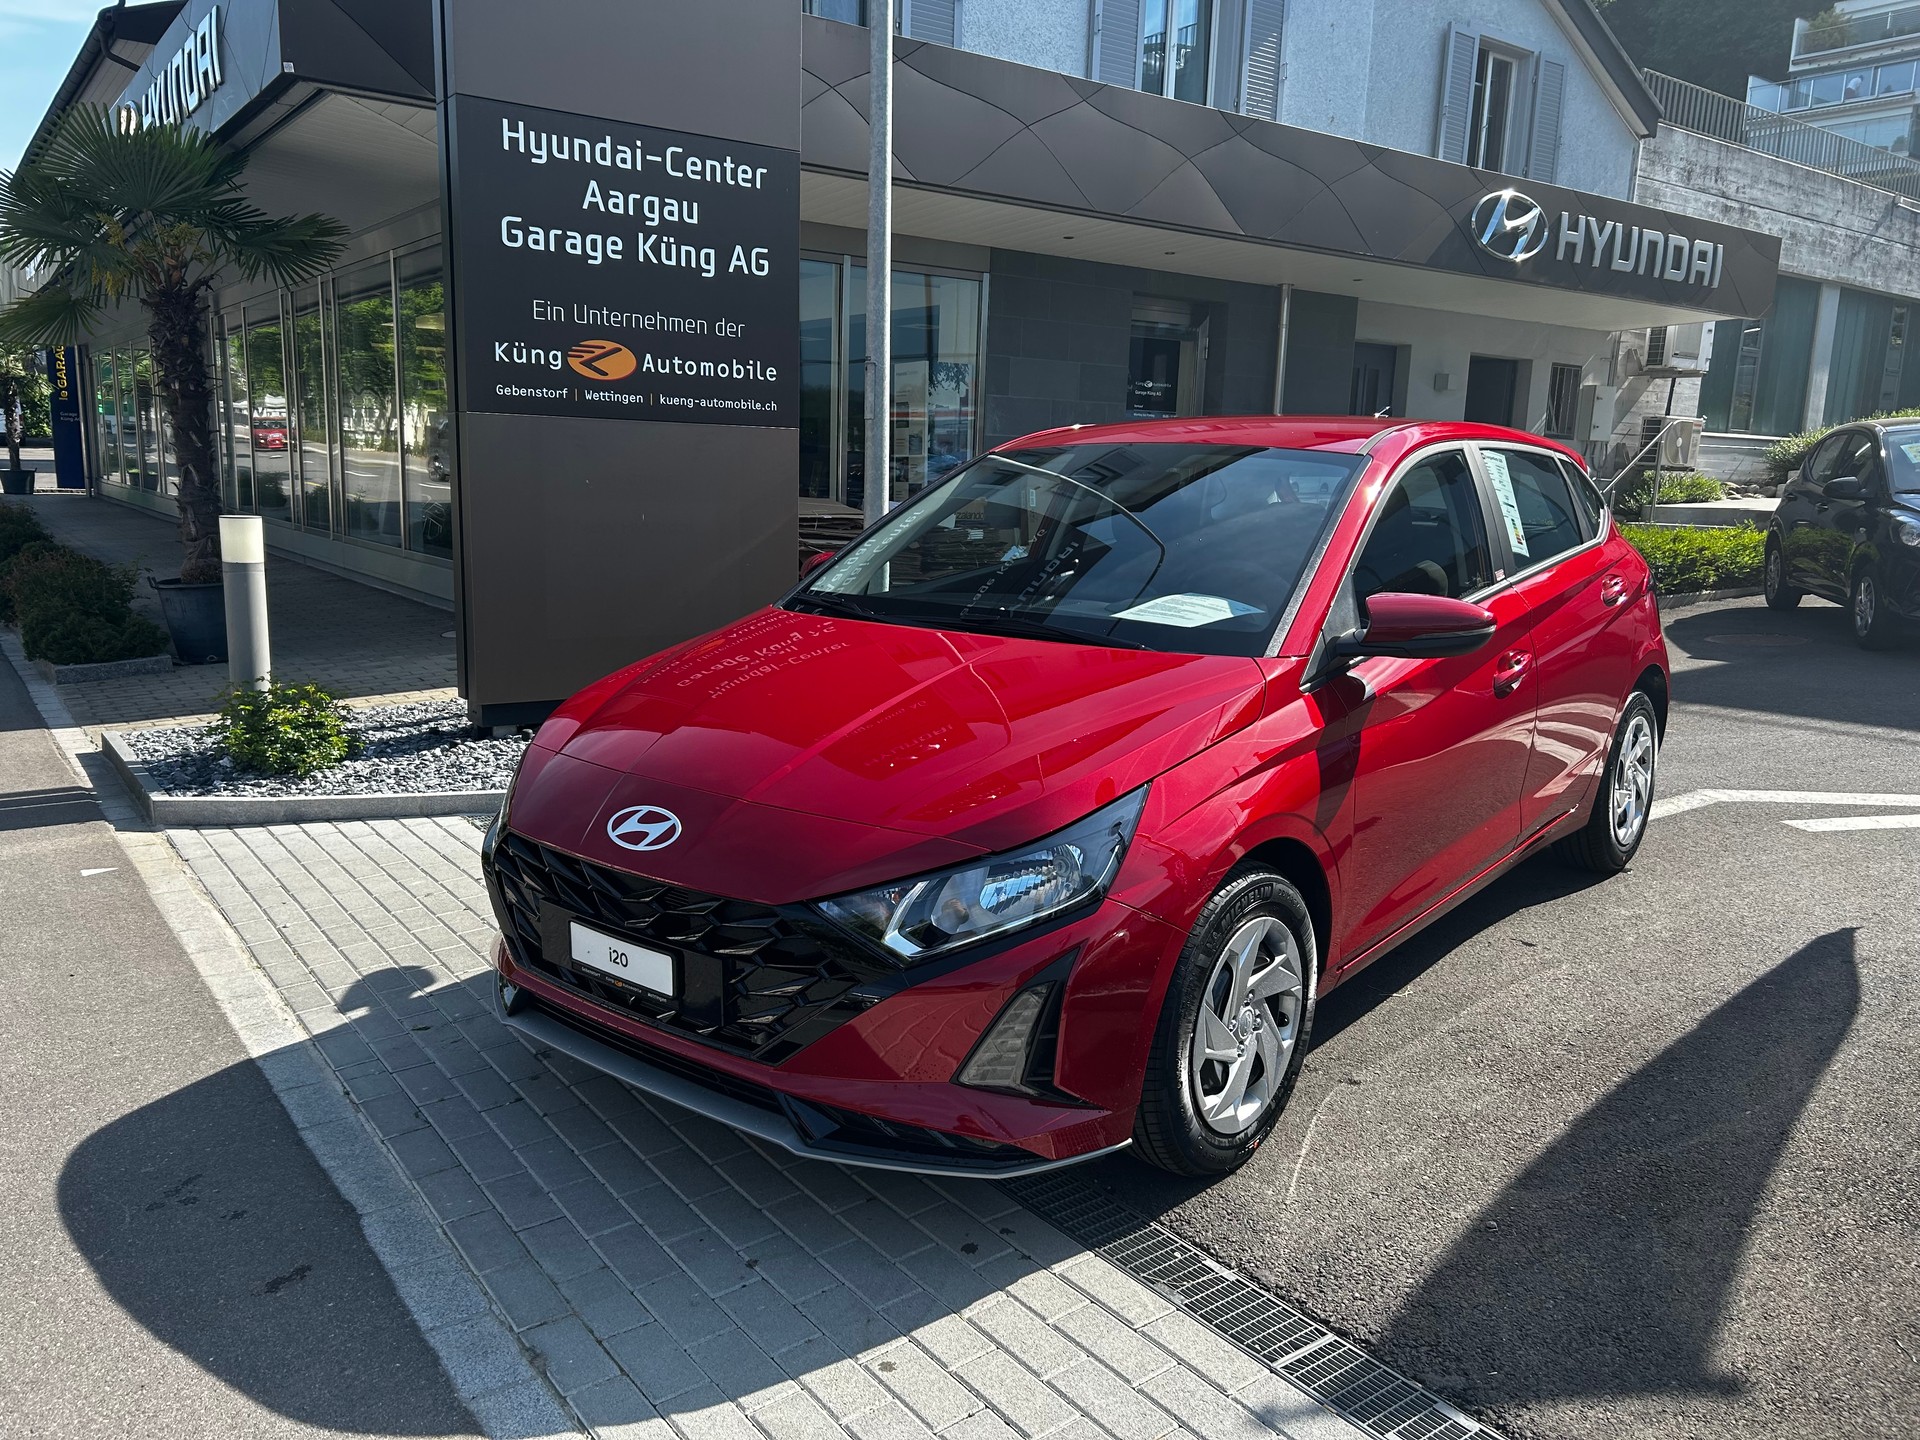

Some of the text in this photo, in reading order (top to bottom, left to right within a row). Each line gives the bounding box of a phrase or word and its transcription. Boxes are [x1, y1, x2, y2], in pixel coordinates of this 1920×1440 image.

[502, 117, 768, 190] Hyundai-Center
[582, 180, 699, 226] Aargau
[501, 215, 769, 278] Garage Küng AG
[1556, 210, 1724, 288] HYUNDAI
[533, 300, 746, 338] Ein Unternehmen der
[494, 341, 777, 382] Küng Automobile
[496, 384, 778, 412] Gebenstorf Wettingen kueng-automobile.ch
[608, 947, 628, 968] i20
